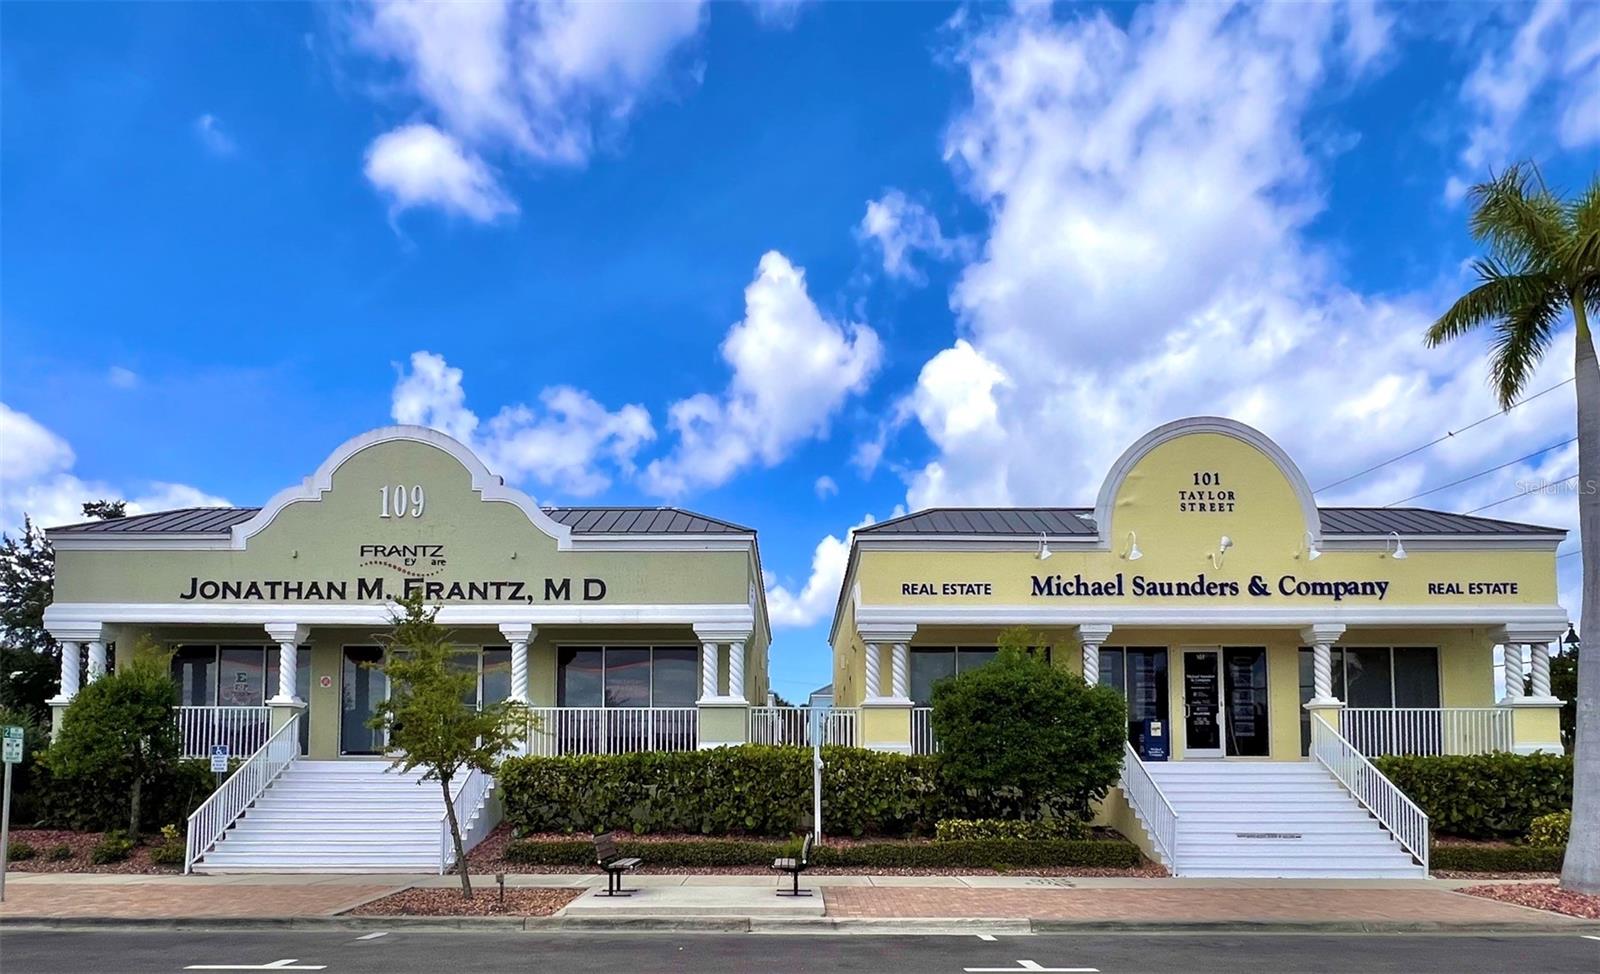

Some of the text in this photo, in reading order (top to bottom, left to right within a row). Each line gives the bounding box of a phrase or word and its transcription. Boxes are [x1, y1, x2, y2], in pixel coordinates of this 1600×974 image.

[1193, 472, 1221, 486] 101
[379, 484, 424, 517] 109
[1179, 491, 1236, 501] TAYLOR
[1180, 503, 1235, 513] STREET
[360, 545, 444, 557] FRANTZ
[180, 577, 347, 600] JONATHAN
[357, 578, 392, 600] M.
[545, 578, 571, 600] M
[583, 578, 607, 600] D
[902, 583, 992, 595] REAL ESTATE
[1030, 573, 1390, 602] Michael Saunders & Company
[1428, 582, 1518, 595] REAL ESTATE
[236, 672, 247, 683] E
[4, 727, 10, 737] 2
